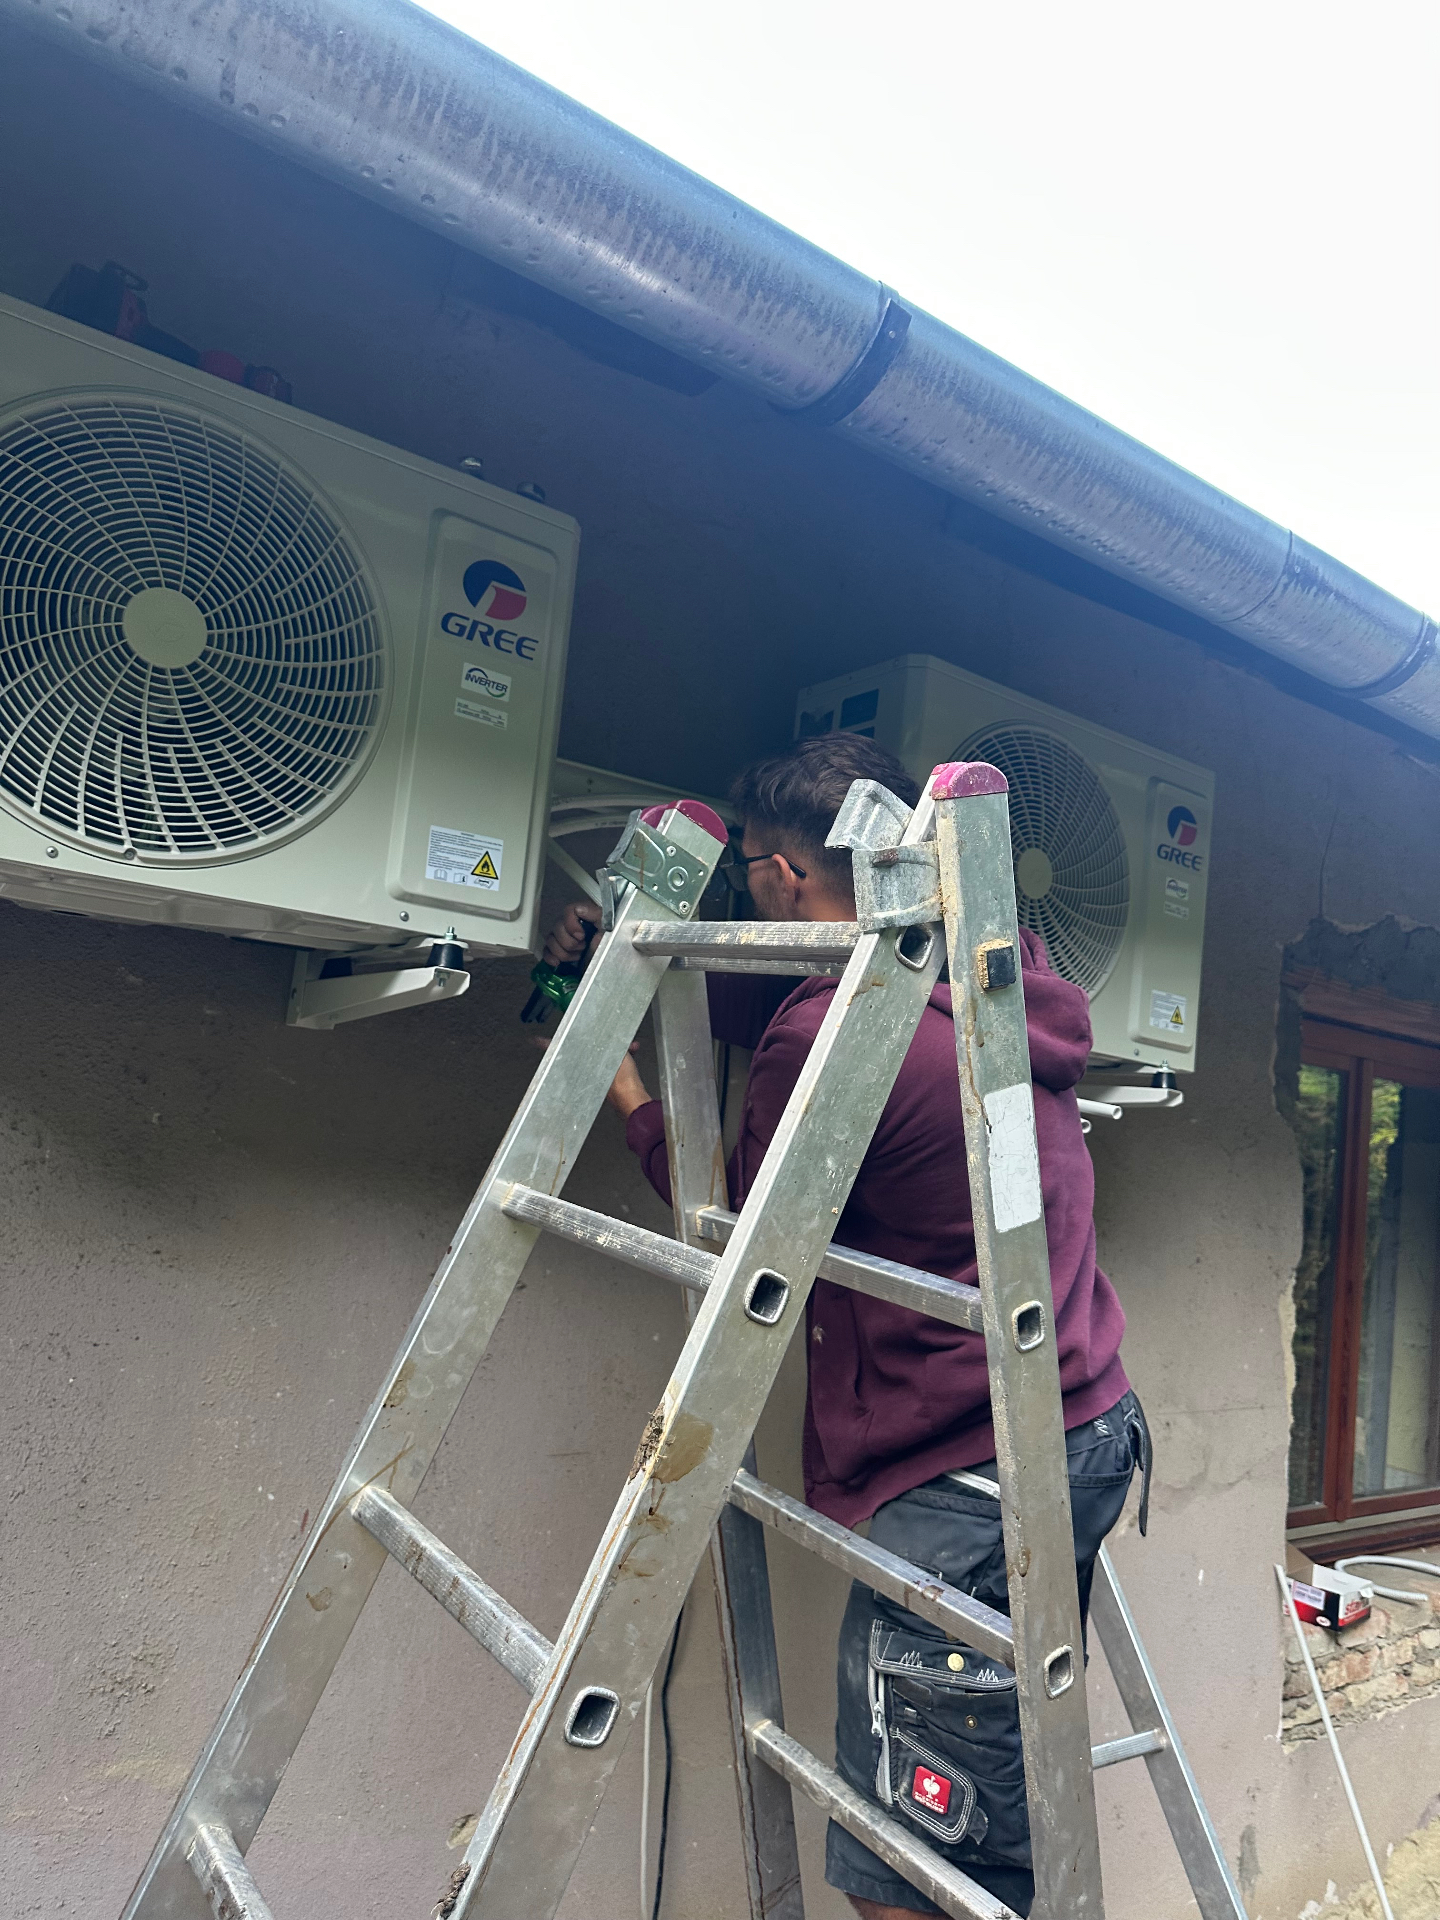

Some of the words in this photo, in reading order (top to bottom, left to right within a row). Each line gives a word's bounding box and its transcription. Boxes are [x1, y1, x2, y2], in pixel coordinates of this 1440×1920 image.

[441, 611, 539, 661] GREE
[464, 673, 508, 693] INVERTER
[1157, 843, 1203, 871] GREE
